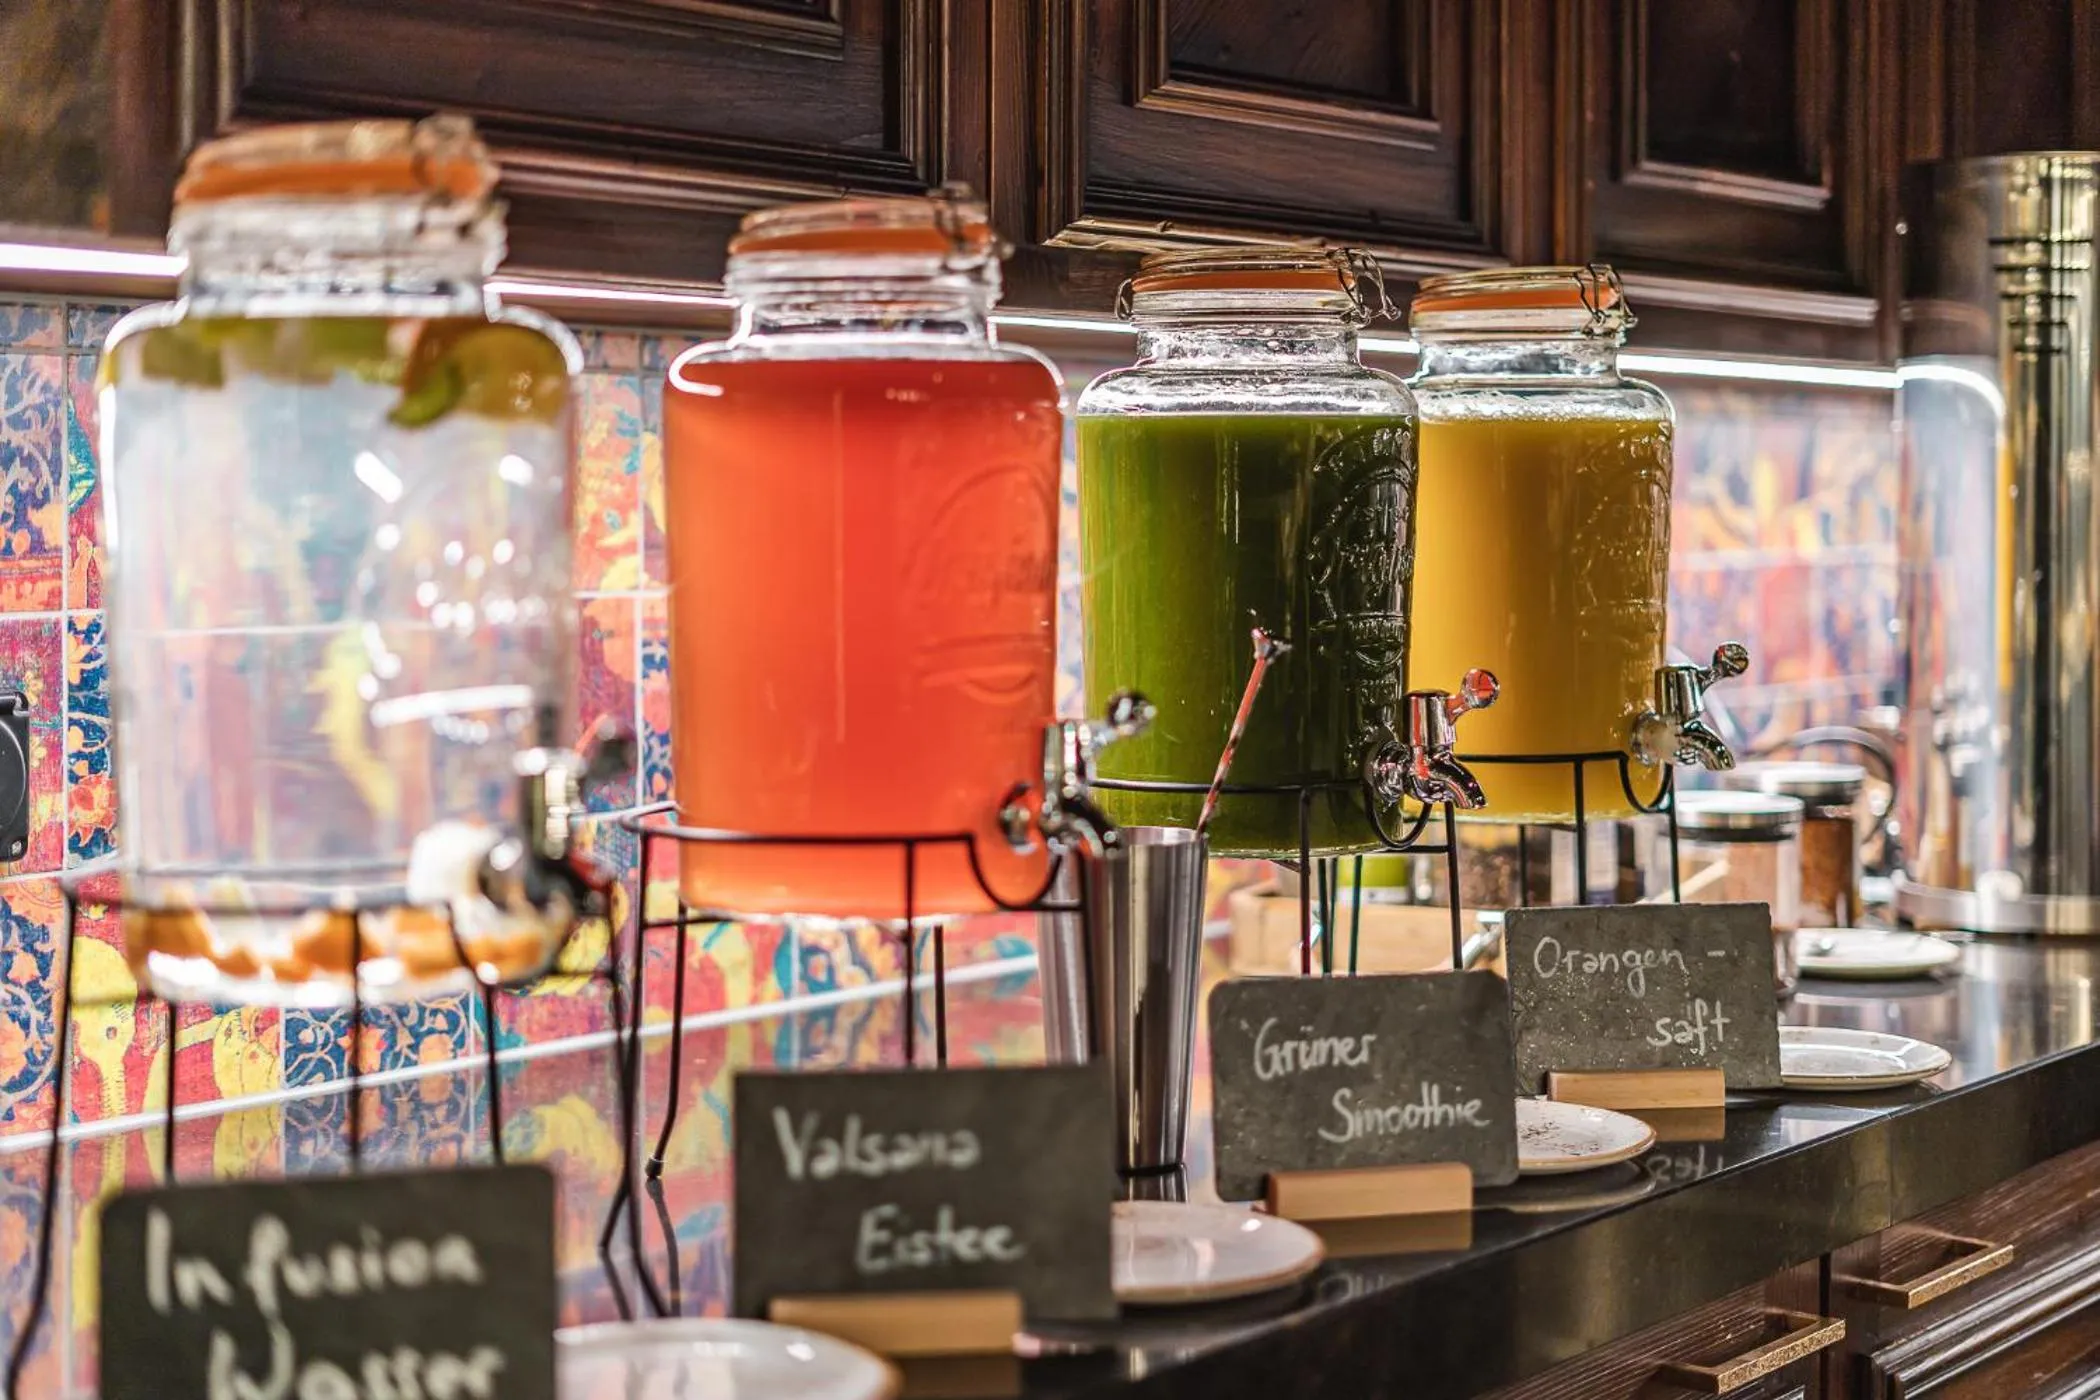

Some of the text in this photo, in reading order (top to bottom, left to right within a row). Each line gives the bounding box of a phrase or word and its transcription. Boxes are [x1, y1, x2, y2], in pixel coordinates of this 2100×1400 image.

[1534, 936, 1690, 998] Orangen
[1254, 1017, 1377, 1080] Grüner
[1646, 998, 1731, 1056] saft
[1317, 1081, 1492, 1143] Smoothie
[855, 1203, 1029, 1274] Eistee
